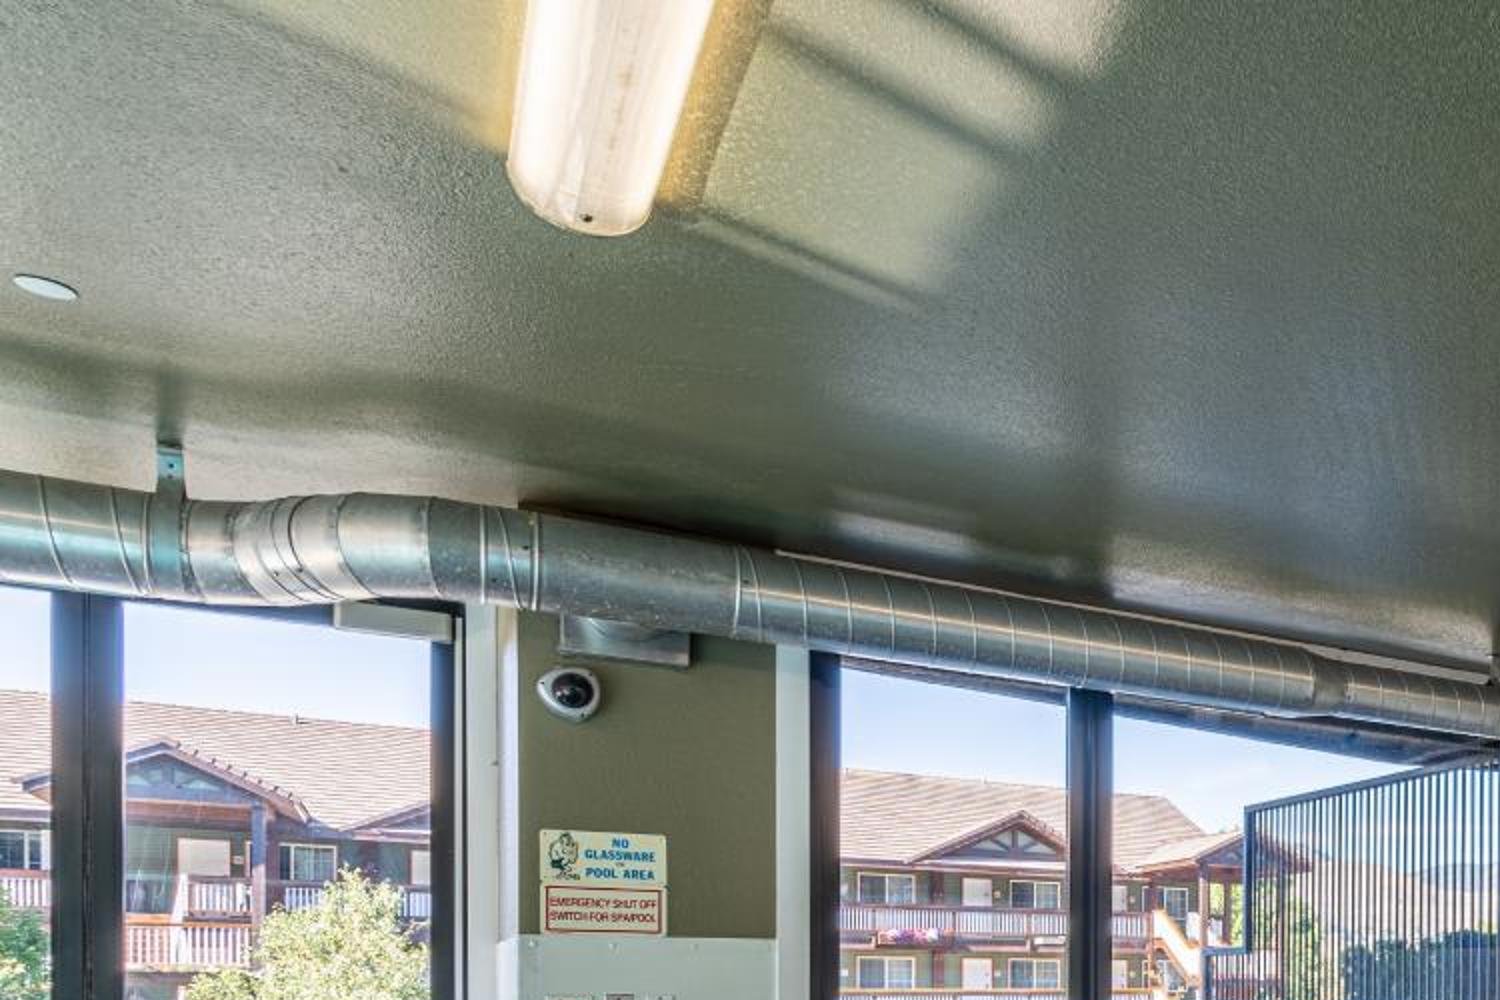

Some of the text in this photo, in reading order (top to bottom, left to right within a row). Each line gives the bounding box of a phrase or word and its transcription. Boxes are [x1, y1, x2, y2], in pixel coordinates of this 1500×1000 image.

[611, 838, 629, 848] NO
[584, 849, 656, 862] GLASSWARE
[585, 867, 655, 880] POOL AREA
[549, 897, 656, 909] EMERGENCY SHUT OFF
[548, 911, 657, 923] SWITCH FOR SPA/POOL
